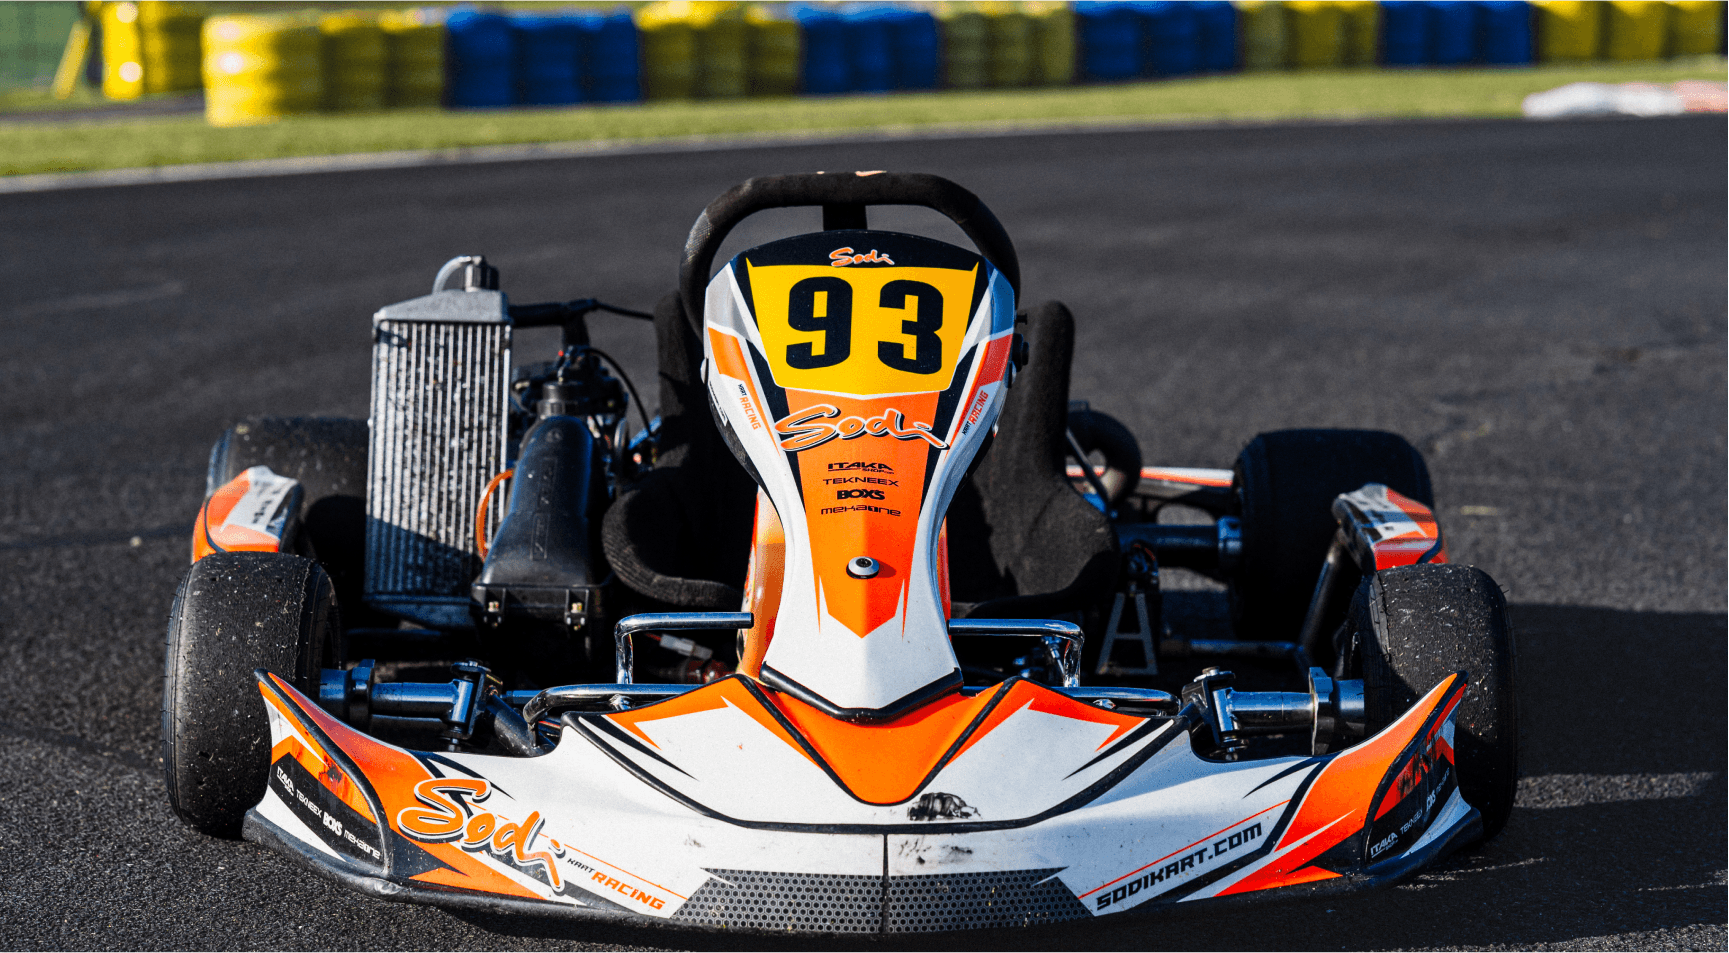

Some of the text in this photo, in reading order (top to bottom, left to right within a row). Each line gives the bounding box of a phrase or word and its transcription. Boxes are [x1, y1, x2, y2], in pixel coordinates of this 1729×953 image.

[829, 247, 895, 267] Sodi
[786, 276, 943, 375] 93
[740, 396, 761, 430] RACING
[968, 390, 989, 425] RACING
[774, 404, 950, 452] Sodi
[823, 477, 899, 487] TEKNEEX
[828, 462, 893, 471] ITAKA
[397, 778, 566, 897] Sodi
[1371, 832, 1398, 856] ITAKA
[567, 858, 666, 910] KART RACING
[1096, 822, 1262, 911] SODIKART.COM
